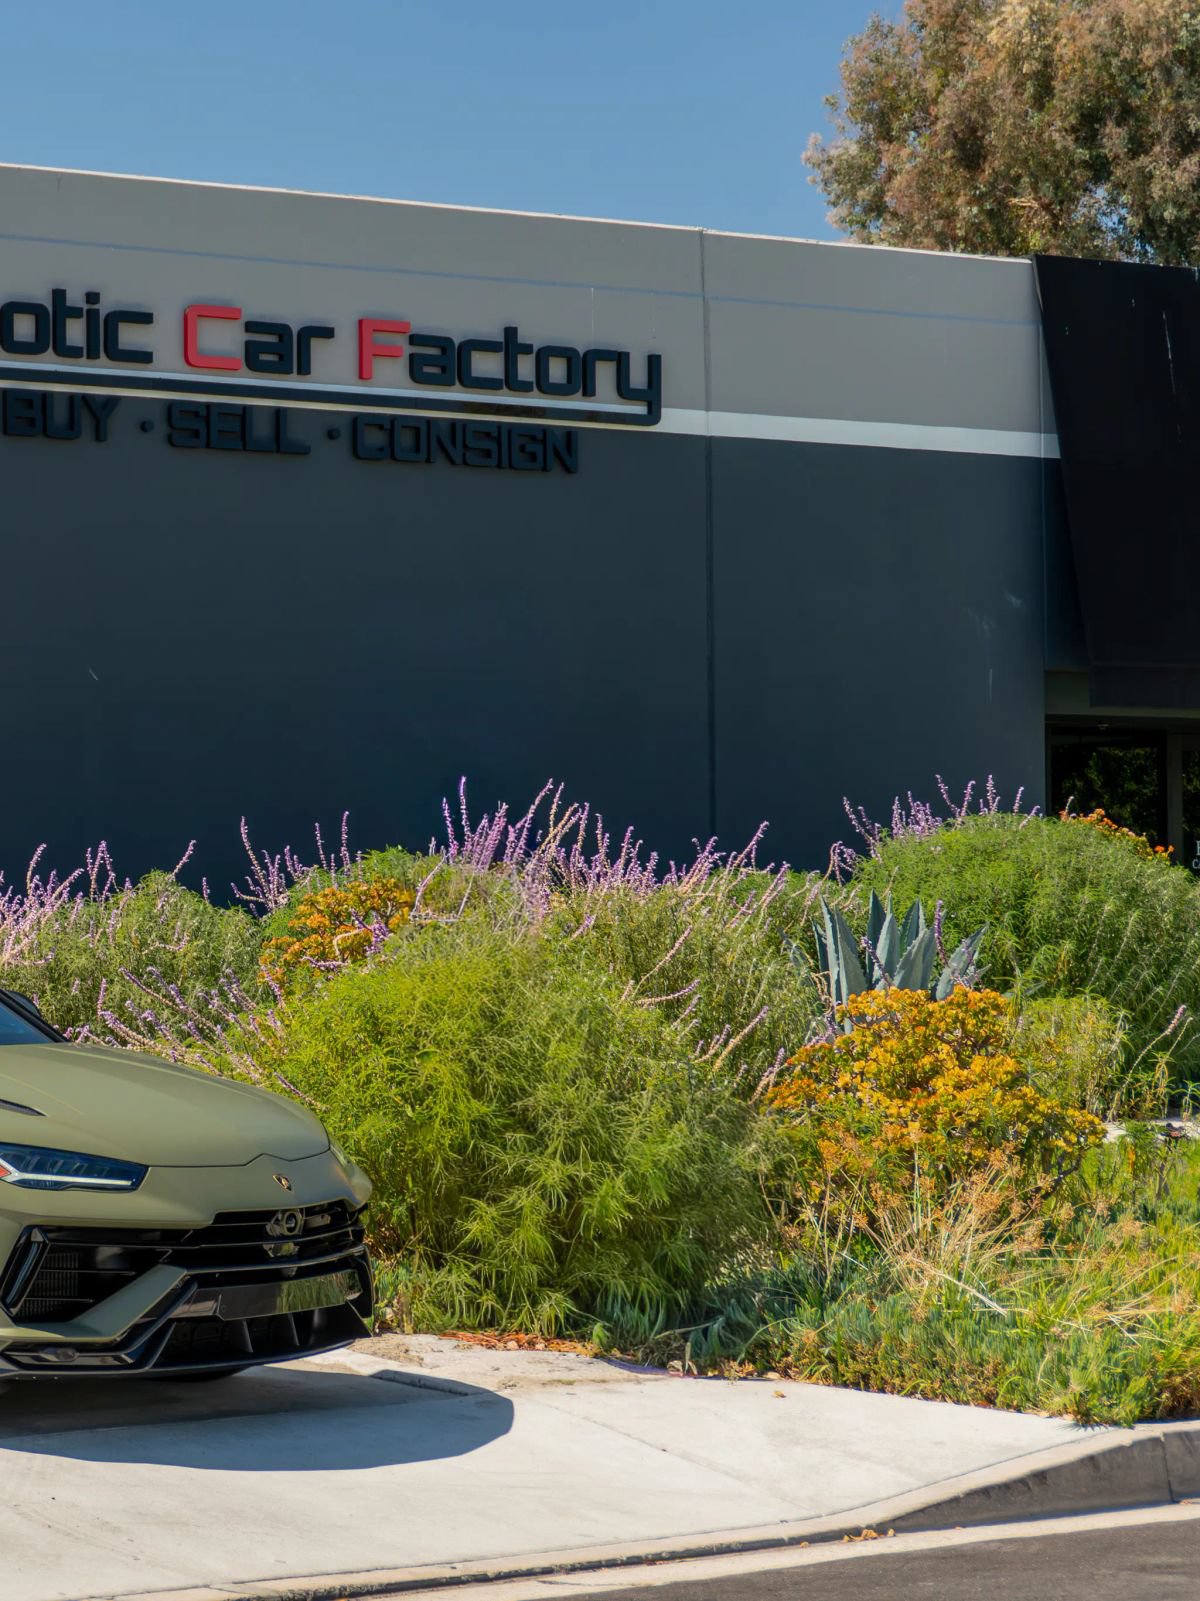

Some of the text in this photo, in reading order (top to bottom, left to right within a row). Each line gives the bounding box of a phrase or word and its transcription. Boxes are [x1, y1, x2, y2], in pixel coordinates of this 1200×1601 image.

[184, 304, 335, 375] Car
[358, 318, 662, 426] Factory
[3, 389, 578, 473] BUY SELL CONSIGN
